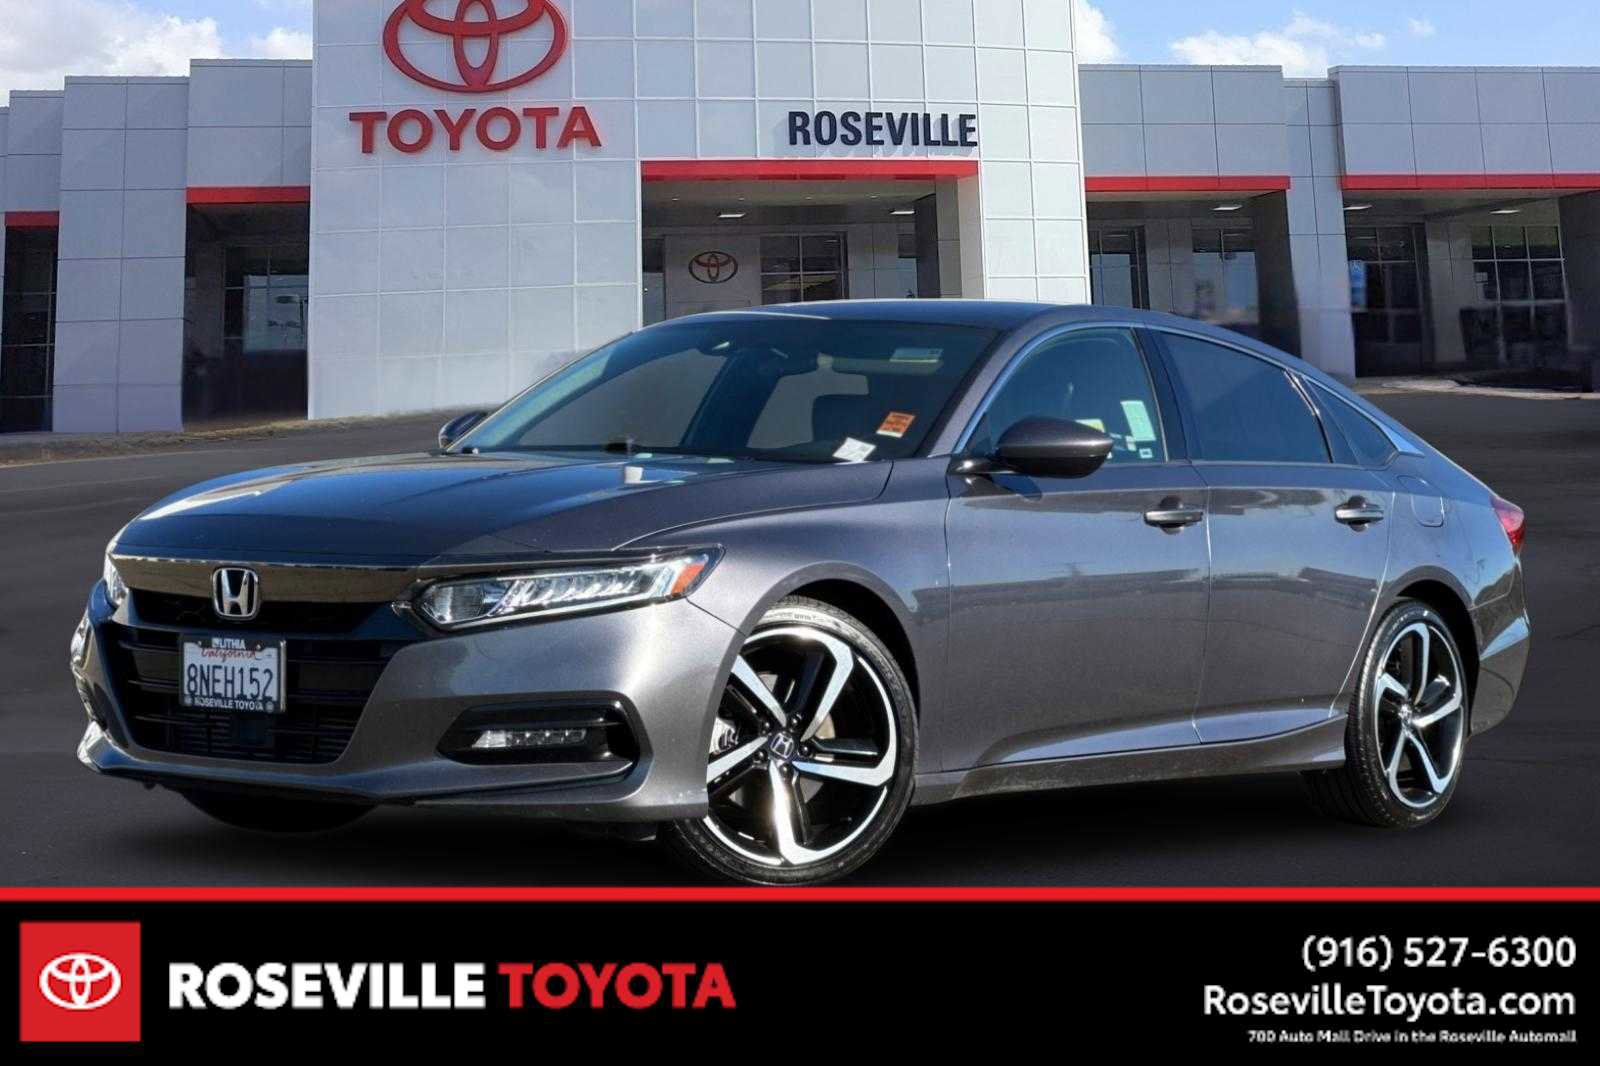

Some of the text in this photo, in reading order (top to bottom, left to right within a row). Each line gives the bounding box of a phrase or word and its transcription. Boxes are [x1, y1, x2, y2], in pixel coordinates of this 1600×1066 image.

[349, 106, 602, 154] TOYOTA
[788, 111, 978, 147] ROSEVILLE
[187, 663, 273, 700] 8NEH152
[194, 696, 264, 711] ROSEVILLE TOYOTA
